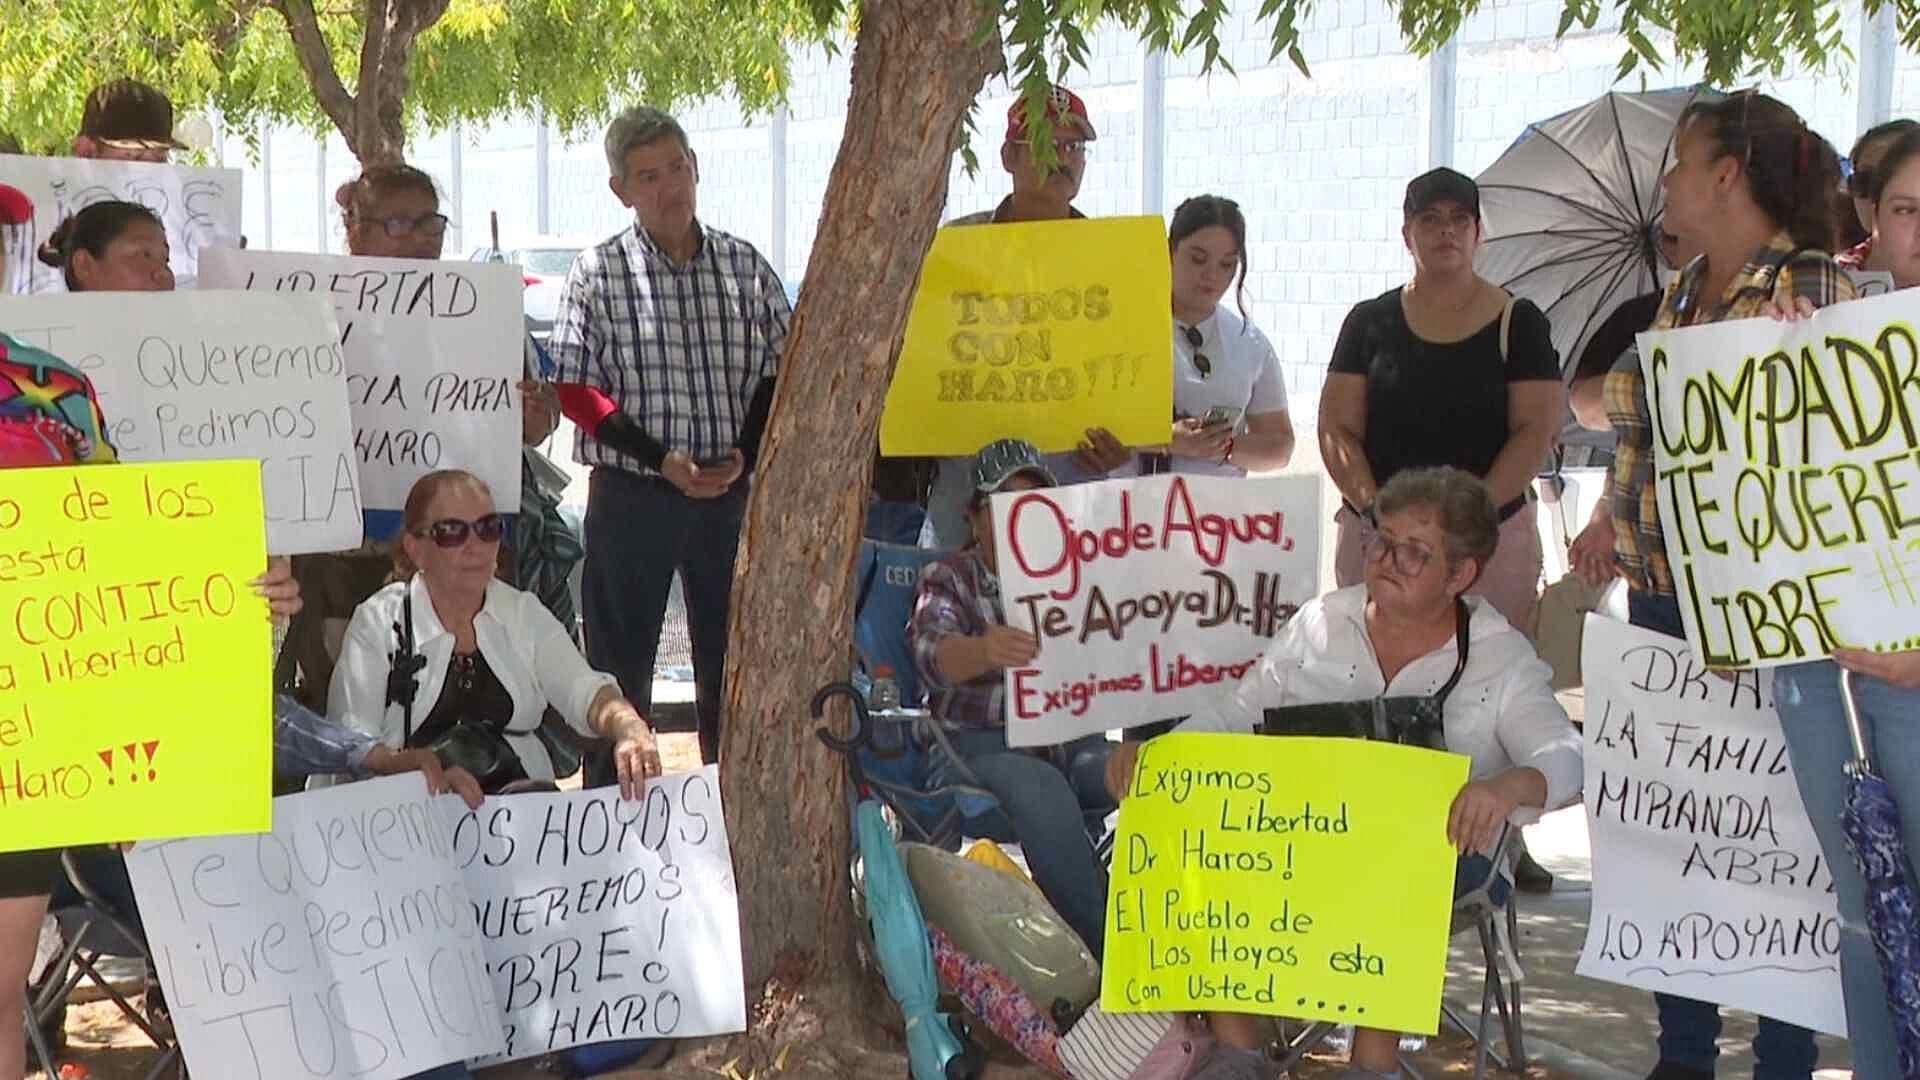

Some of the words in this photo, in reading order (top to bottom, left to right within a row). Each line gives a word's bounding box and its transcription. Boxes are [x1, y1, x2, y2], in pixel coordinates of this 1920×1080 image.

[949, 283, 1112, 326] TODOS
[137, 336, 344, 390] Queremos
[948, 328, 1051, 368] CON
[425, 372, 513, 414] PARA
[156, 400, 317, 453] Pedimos
[63, 476, 112, 521] de
[144, 474, 216, 520] los
[1660, 461, 1728, 557] TE
[16, 573, 235, 645] CONTIGO
[1014, 593, 1074, 658] Te
[1078, 585, 1210, 644] Apoya
[41, 626, 186, 684] libertad
[1013, 669, 1144, 719] Exigimos
[1595, 700, 1638, 760] LA
[1134, 742, 1272, 803] Exigimos
[535, 775, 711, 867] HOYOS
[1221, 799, 1348, 833] Libertad
[1596, 771, 1779, 846] MIRANDA
[142, 837, 241, 922] Te
[1128, 833, 1157, 875] Dr
[471, 866, 682, 938] UEREMOS
[1116, 888, 1145, 933] El
[1165, 889, 1250, 930] Pueblo
[1270, 899, 1313, 934] de
[1150, 937, 1191, 970] Los
[1211, 936, 1298, 970] Hoyos
[1329, 944, 1385, 976] esta
[1599, 914, 1642, 960] LO
[165, 922, 298, 1009] Libre
[1188, 974, 1275, 1003] Usted
[549, 990, 681, 1048] HARO
